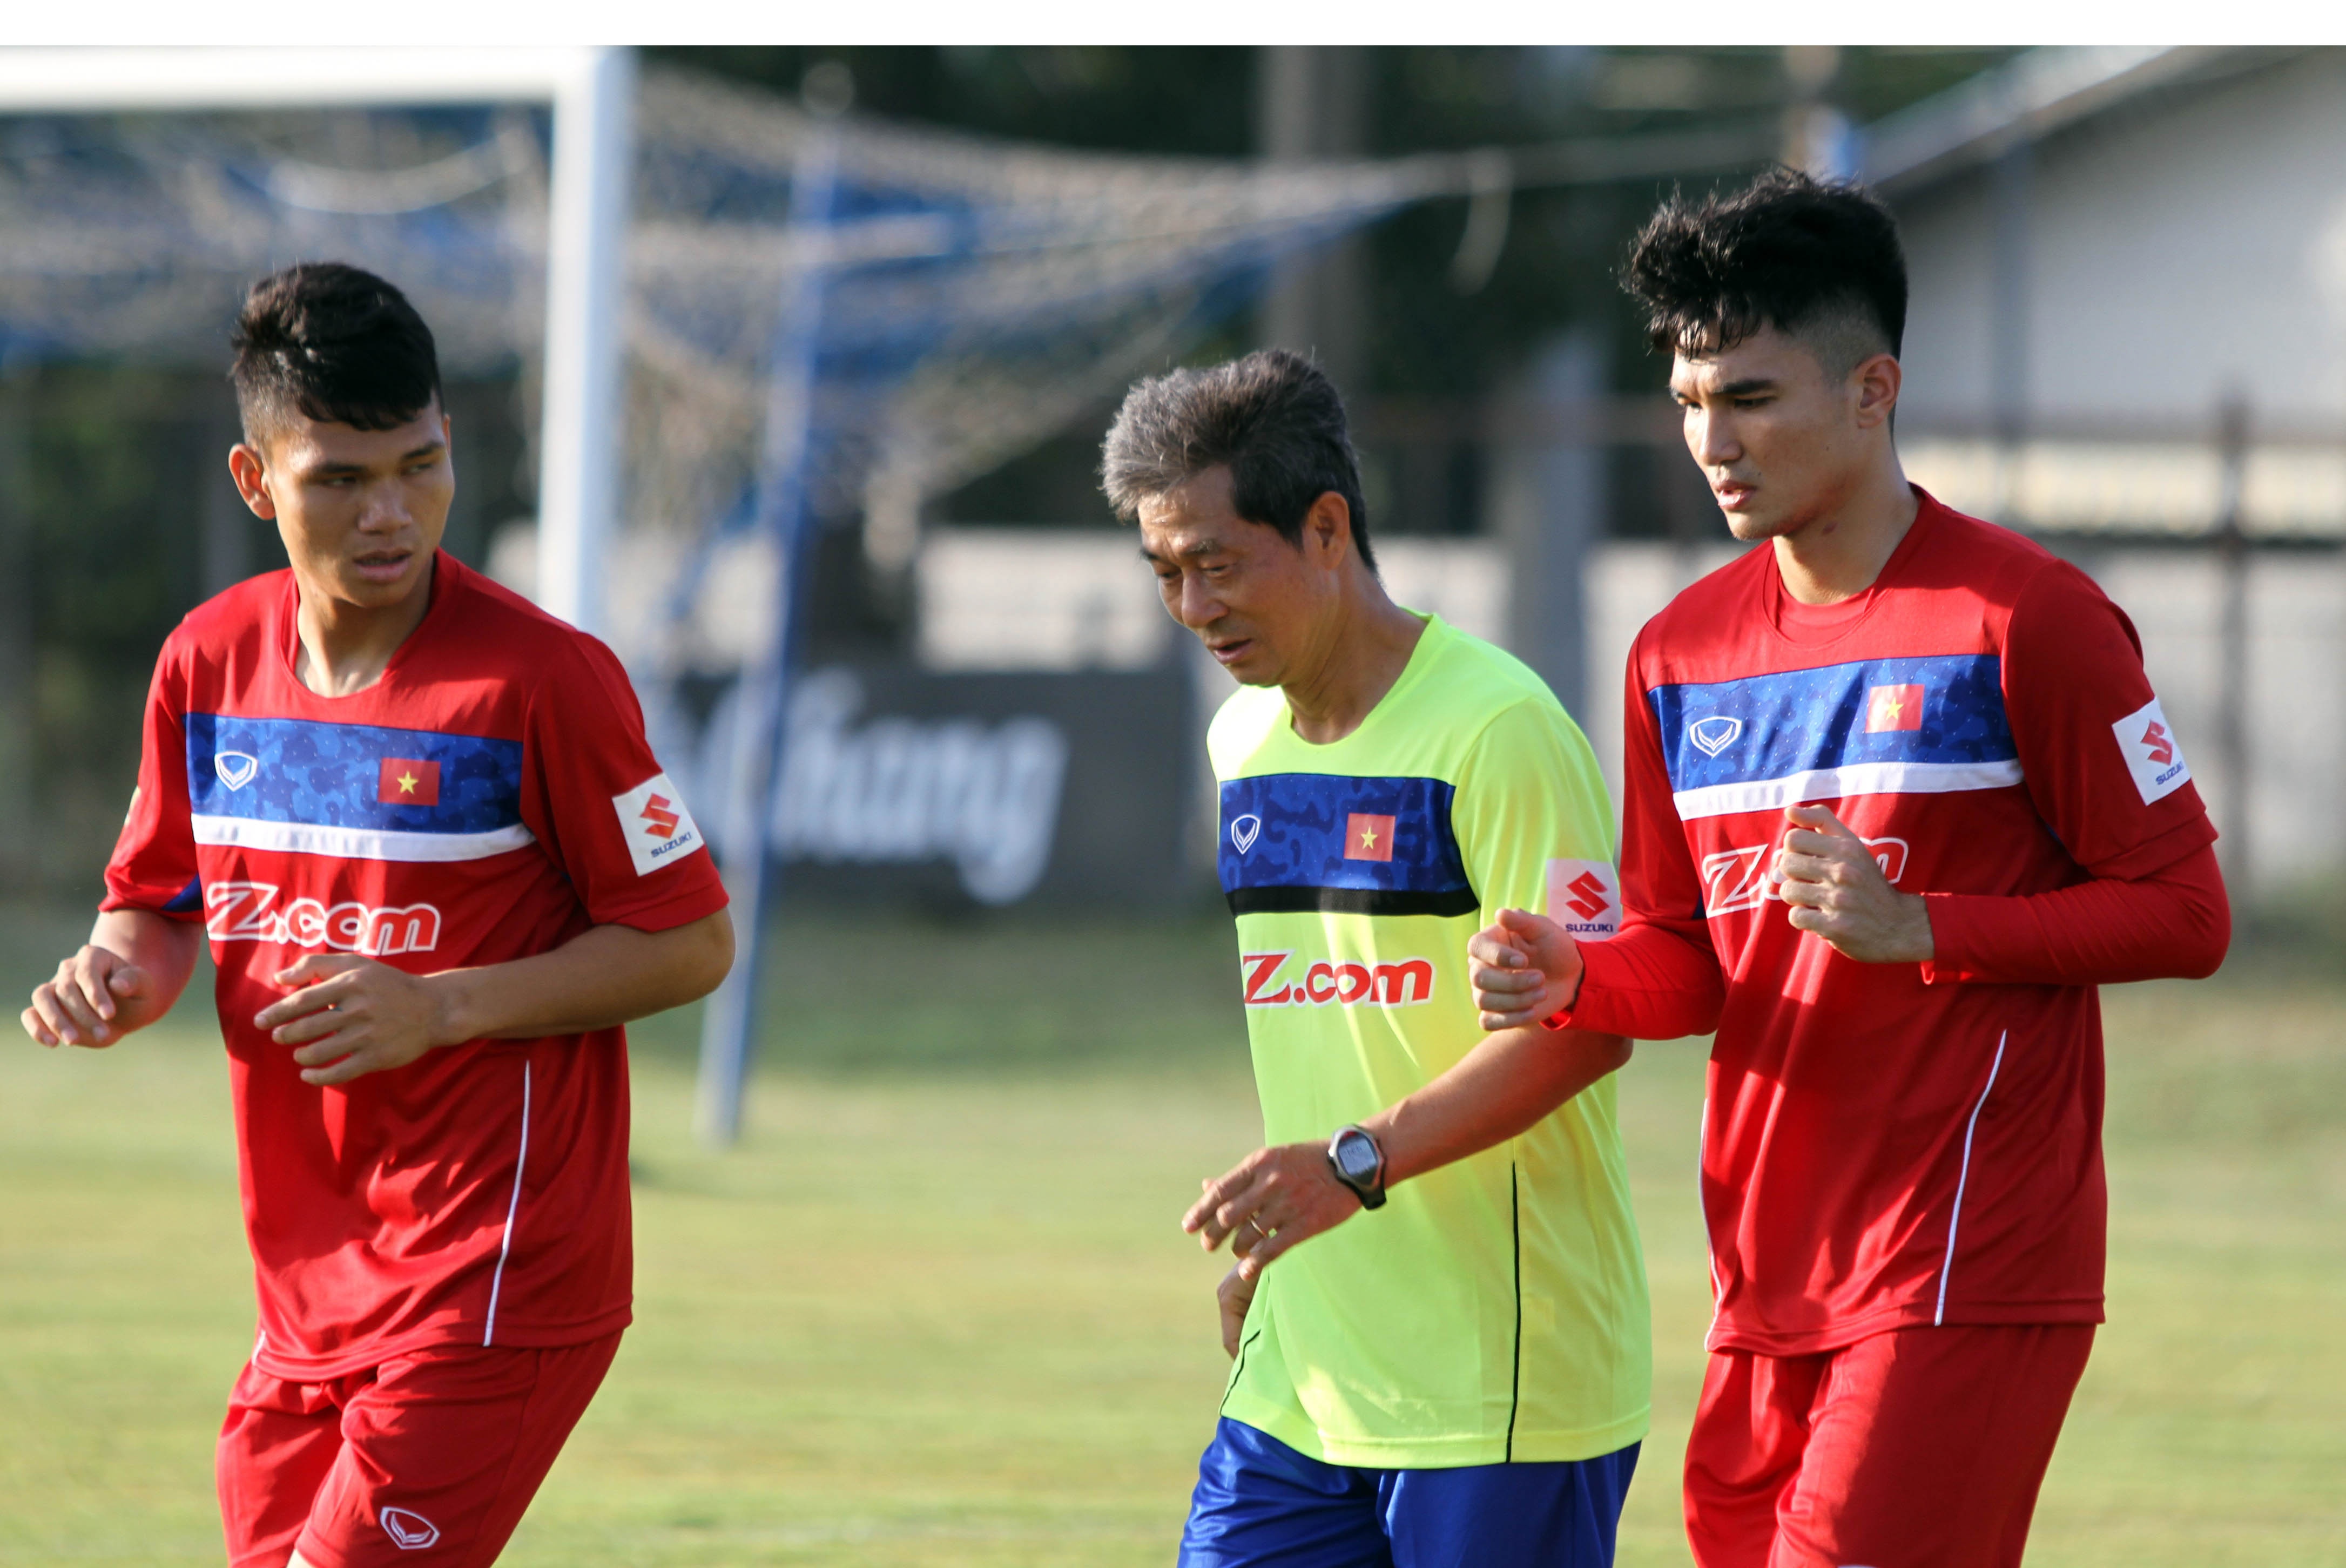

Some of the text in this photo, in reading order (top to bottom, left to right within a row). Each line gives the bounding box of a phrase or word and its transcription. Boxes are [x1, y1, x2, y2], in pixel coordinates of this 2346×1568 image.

[650, 831, 692, 857] SUZUKI
[206, 881, 442, 956] Z.com
[1565, 923, 1614, 932] SUZUKI
[1242, 950, 1437, 1009] Z.com
